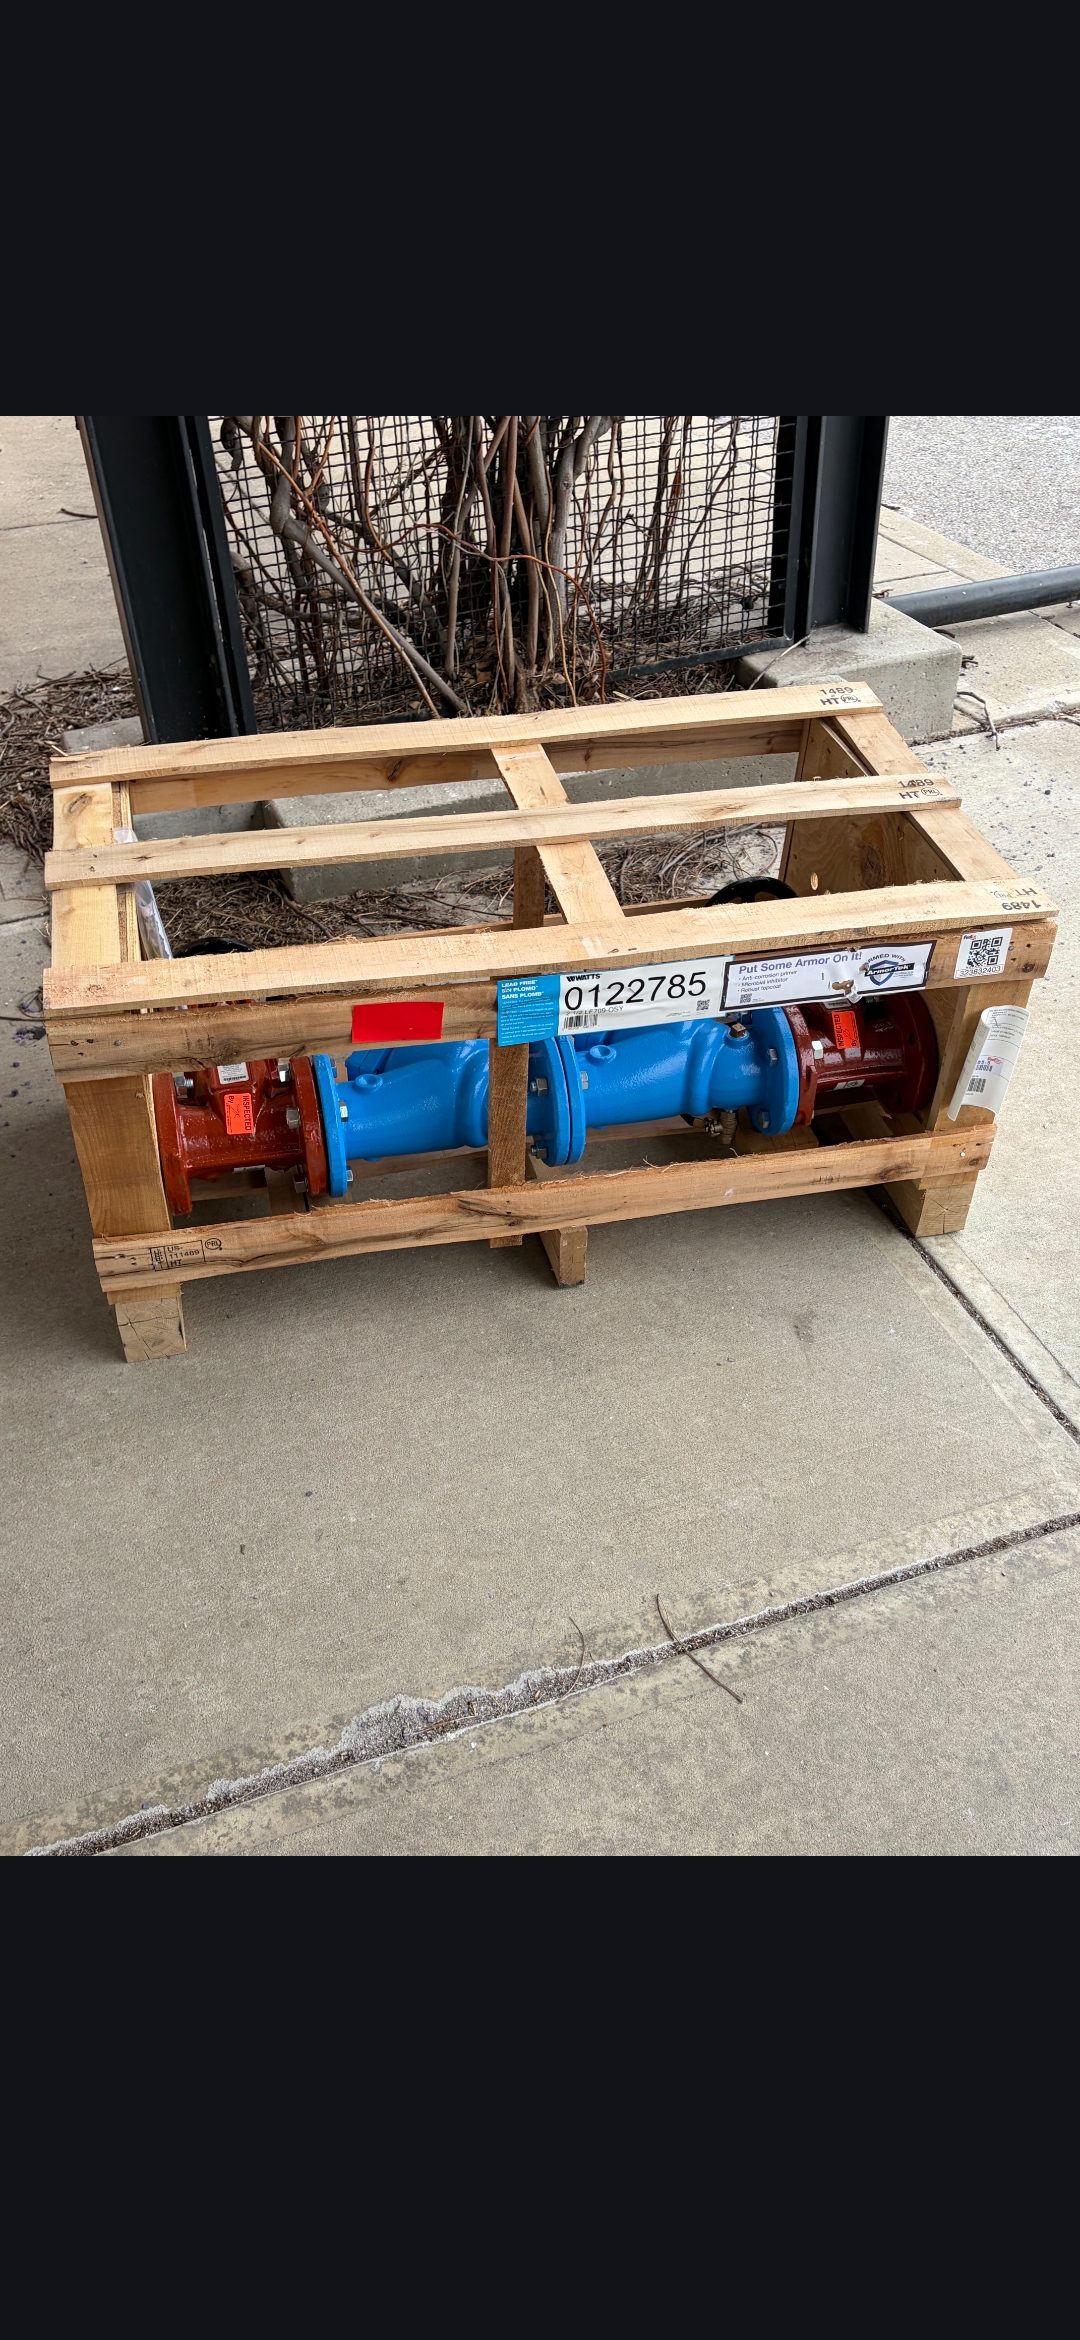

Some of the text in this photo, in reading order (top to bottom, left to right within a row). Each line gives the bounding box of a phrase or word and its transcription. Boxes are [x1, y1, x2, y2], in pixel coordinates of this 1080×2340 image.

[820, 687, 854, 695] 1489
[820, 697, 840, 705] HT
[898, 779, 934, 788] 1489
[899, 791, 919, 799] HT
[739, 951, 863, 974] Put Some Armor On It!
[564, 971, 707, 1011] 0122785
[834, 1014, 844, 1047] INSPECTED
[242, 1095, 252, 1131] INSPECTED
